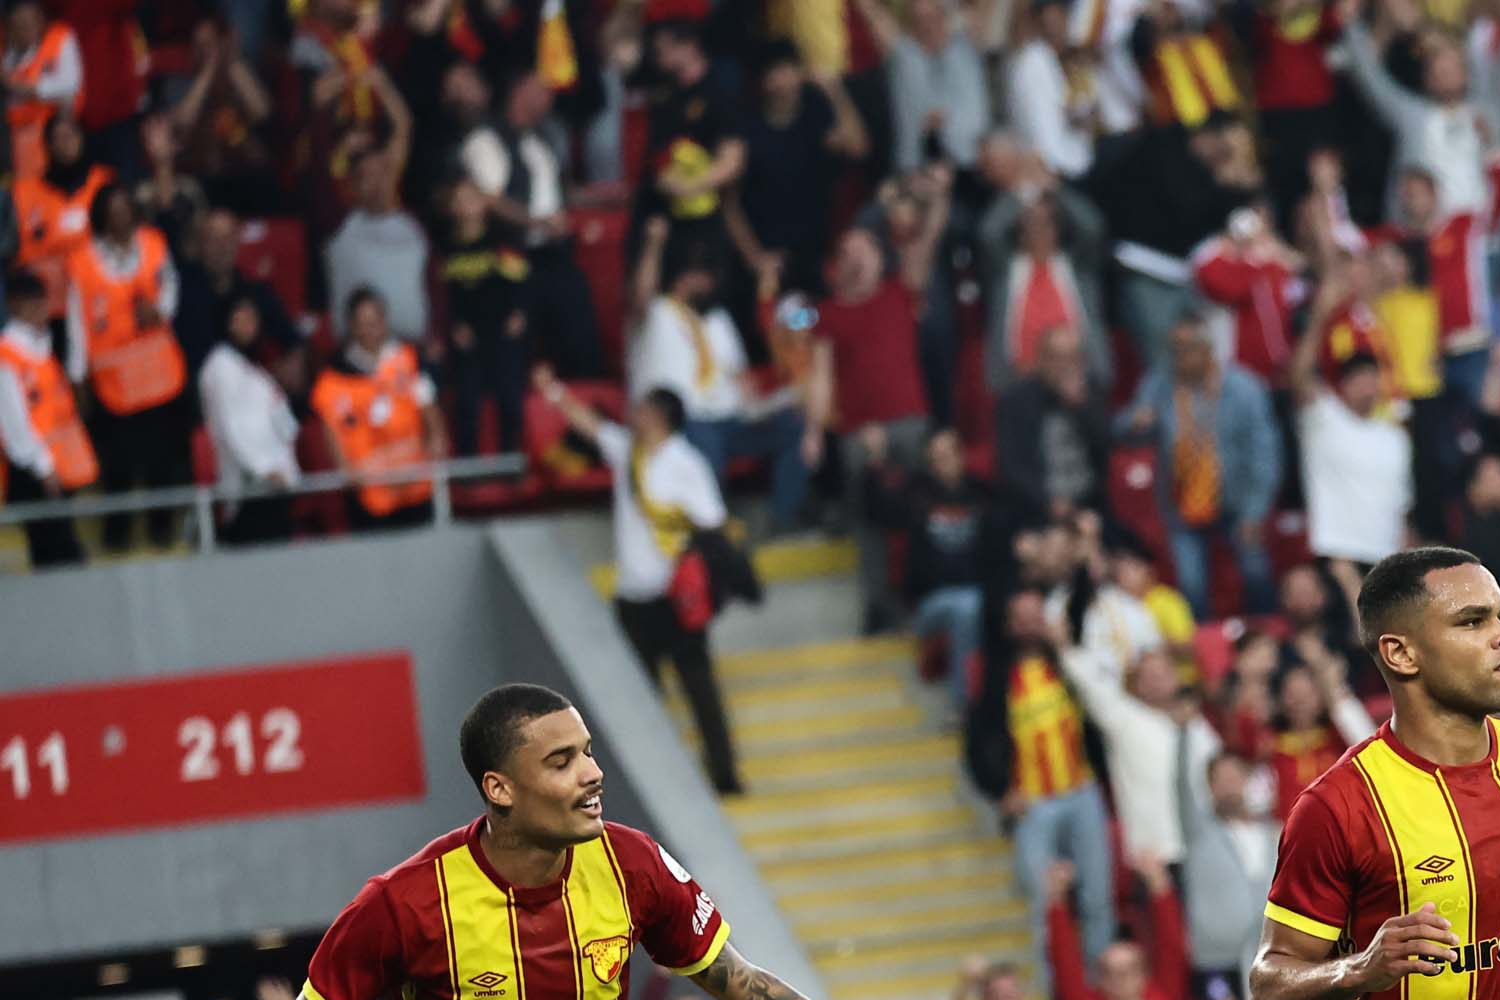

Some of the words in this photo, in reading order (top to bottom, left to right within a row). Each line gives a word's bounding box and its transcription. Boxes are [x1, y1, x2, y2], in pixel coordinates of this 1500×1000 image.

[178, 707, 304, 783] 212
[1421, 873, 1455, 886] umbro
[474, 987, 506, 998] umbro
